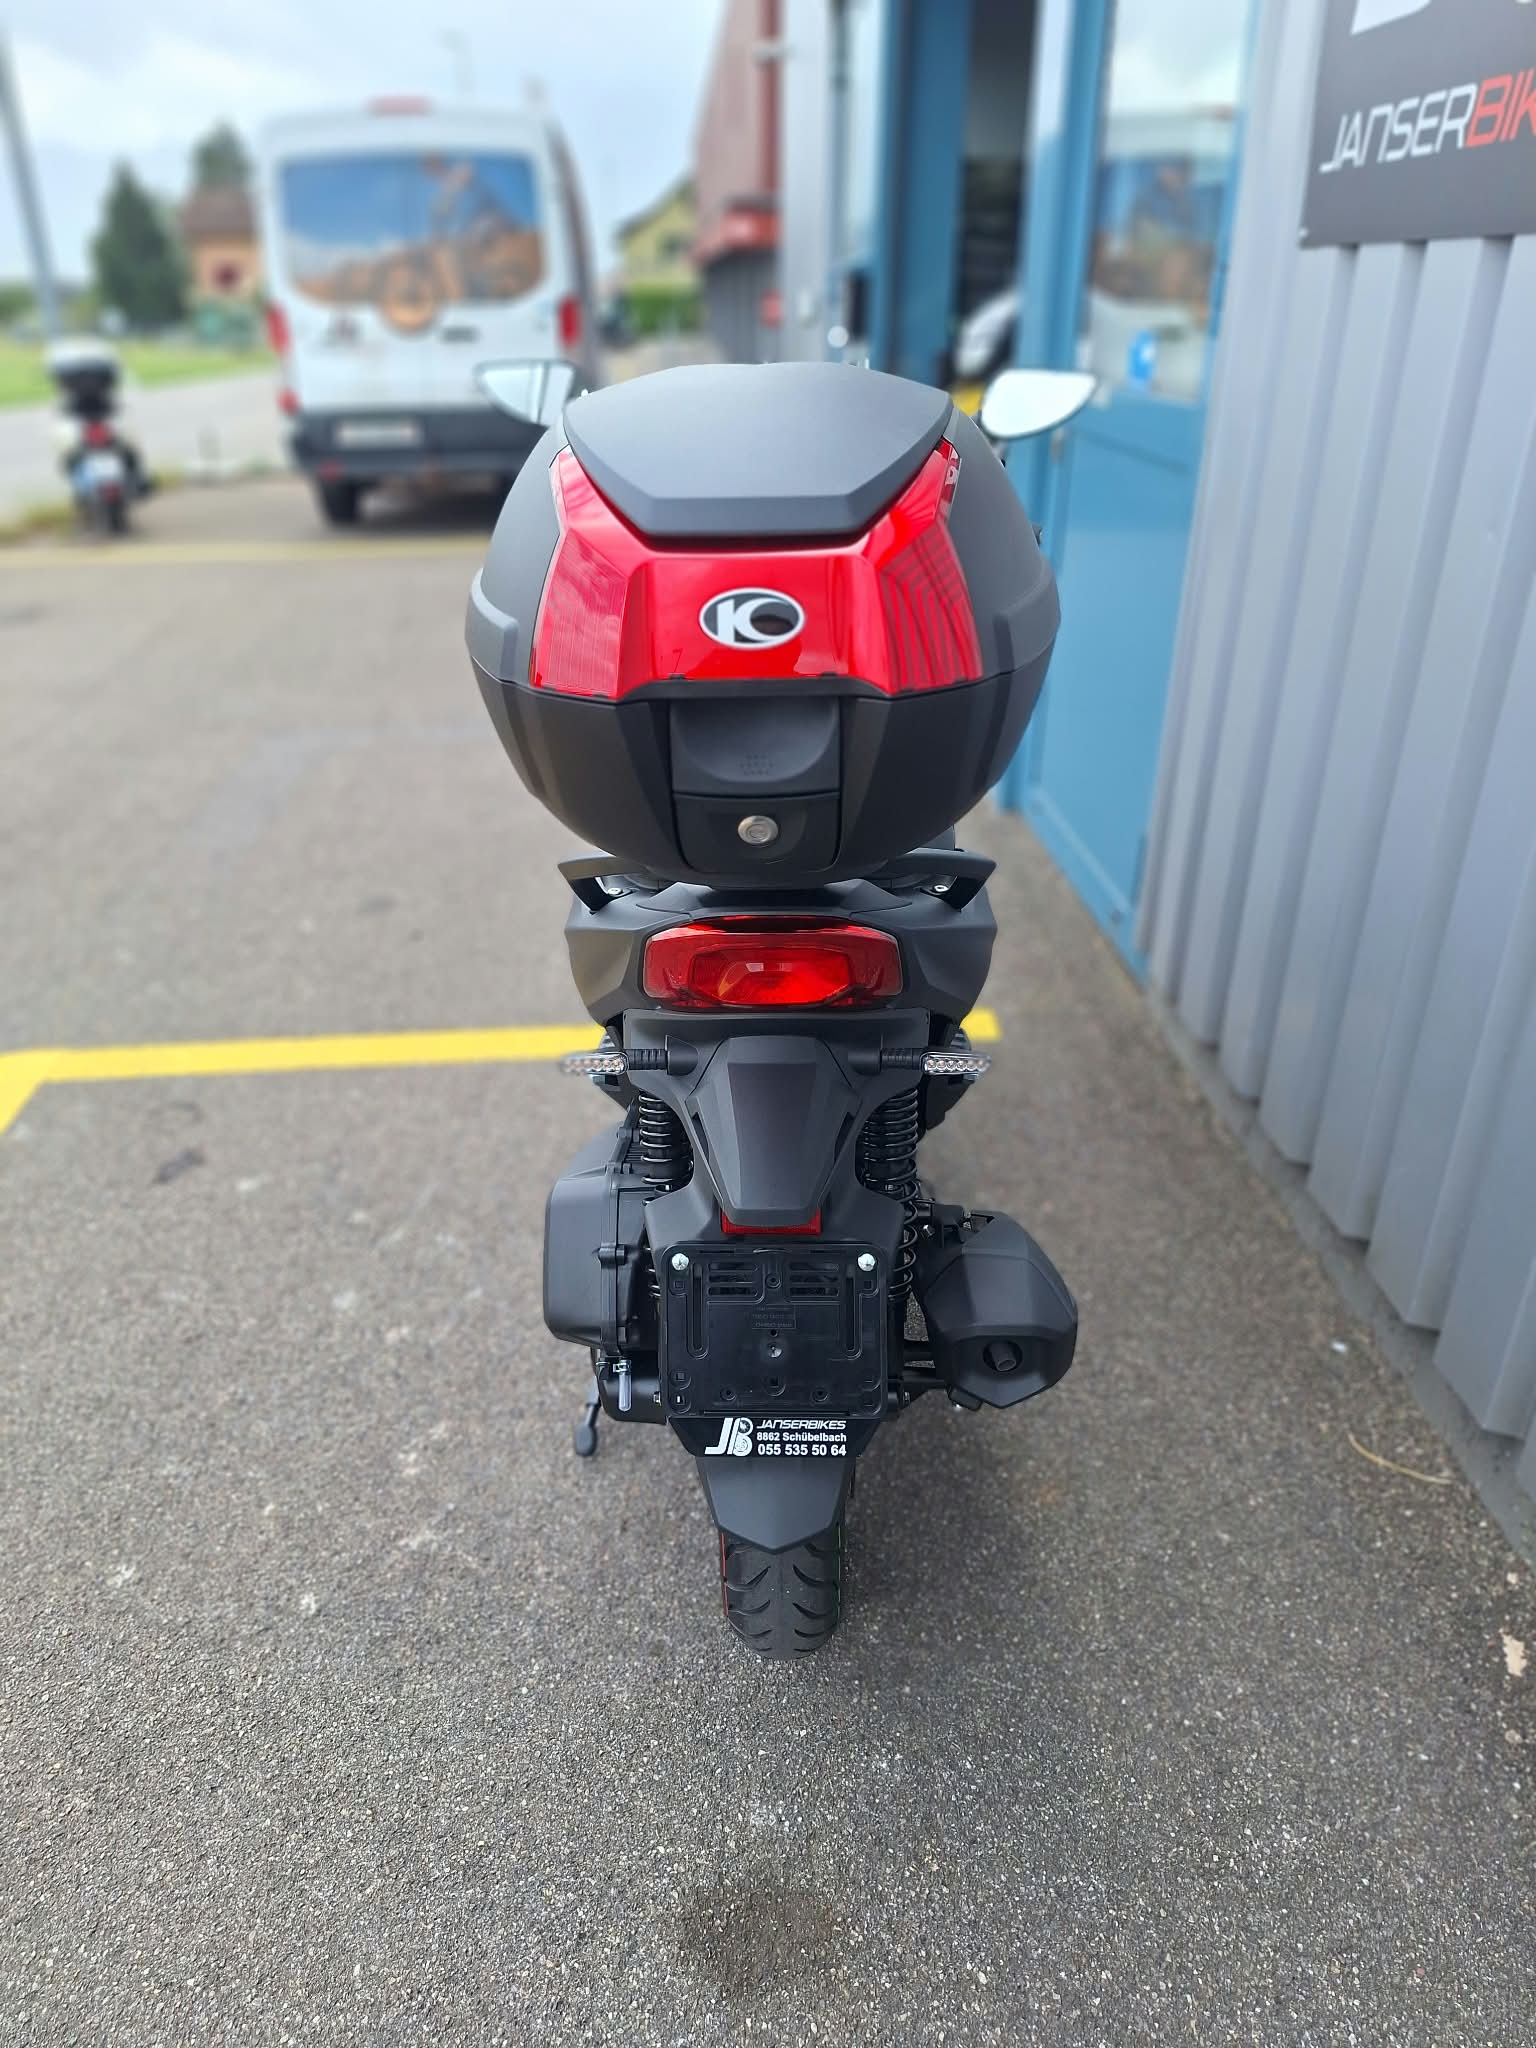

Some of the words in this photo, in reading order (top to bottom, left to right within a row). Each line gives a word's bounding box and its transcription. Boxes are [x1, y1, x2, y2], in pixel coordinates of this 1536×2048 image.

[756, 1419, 847, 1430] JANSERBIKES
[756, 1432, 780, 1441] 8862
[782, 1432, 847, 1442] Schübelbach
[757, 1444, 781, 1455] 055
[784, 1444, 808, 1456] 535
[811, 1444, 828, 1456] 50
[830, 1444, 847, 1456] 64
